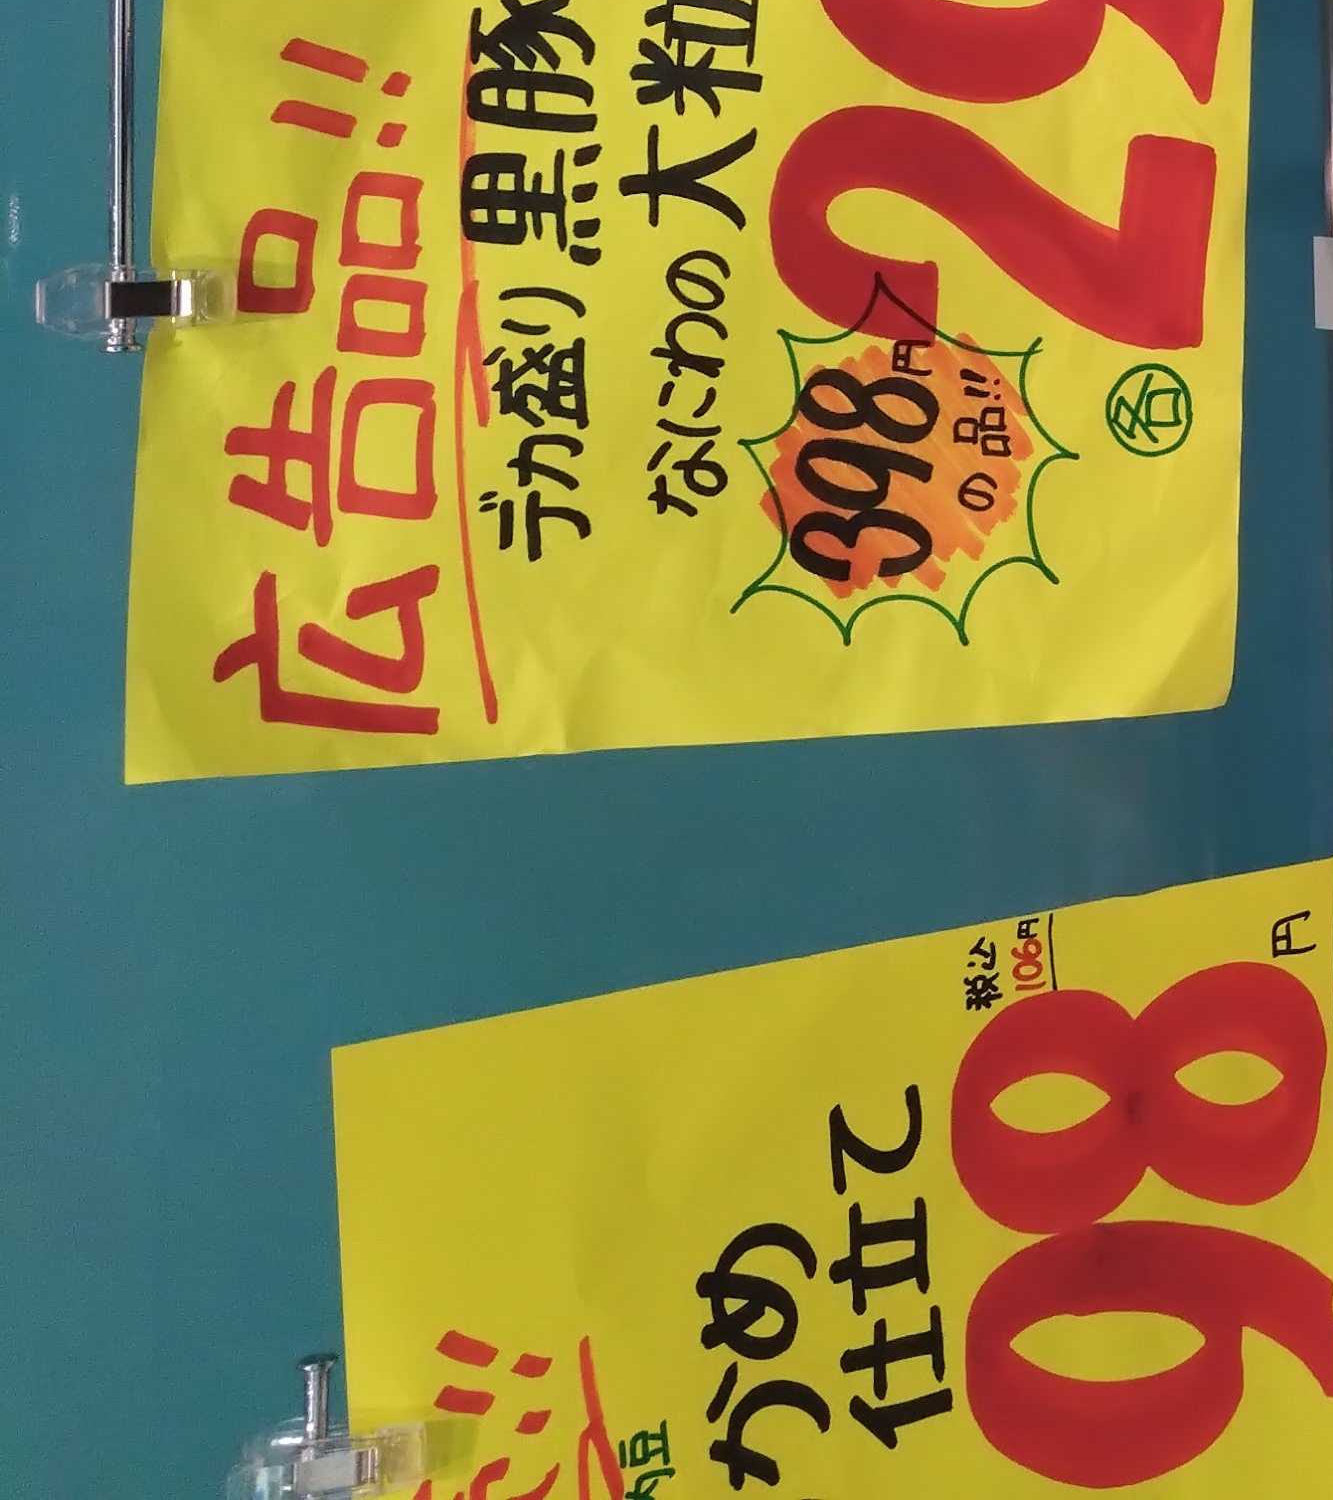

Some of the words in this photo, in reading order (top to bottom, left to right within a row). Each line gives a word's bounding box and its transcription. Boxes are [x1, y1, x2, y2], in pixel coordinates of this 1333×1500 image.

[212, 36, 442, 736] 広告品!!
[478, 285, 592, 563] デカ盛り
[643, 249, 733, 519] なにわの
[963, 936, 1003, 1011] 税込
[828, 1084, 953, 1451] 仕立て
